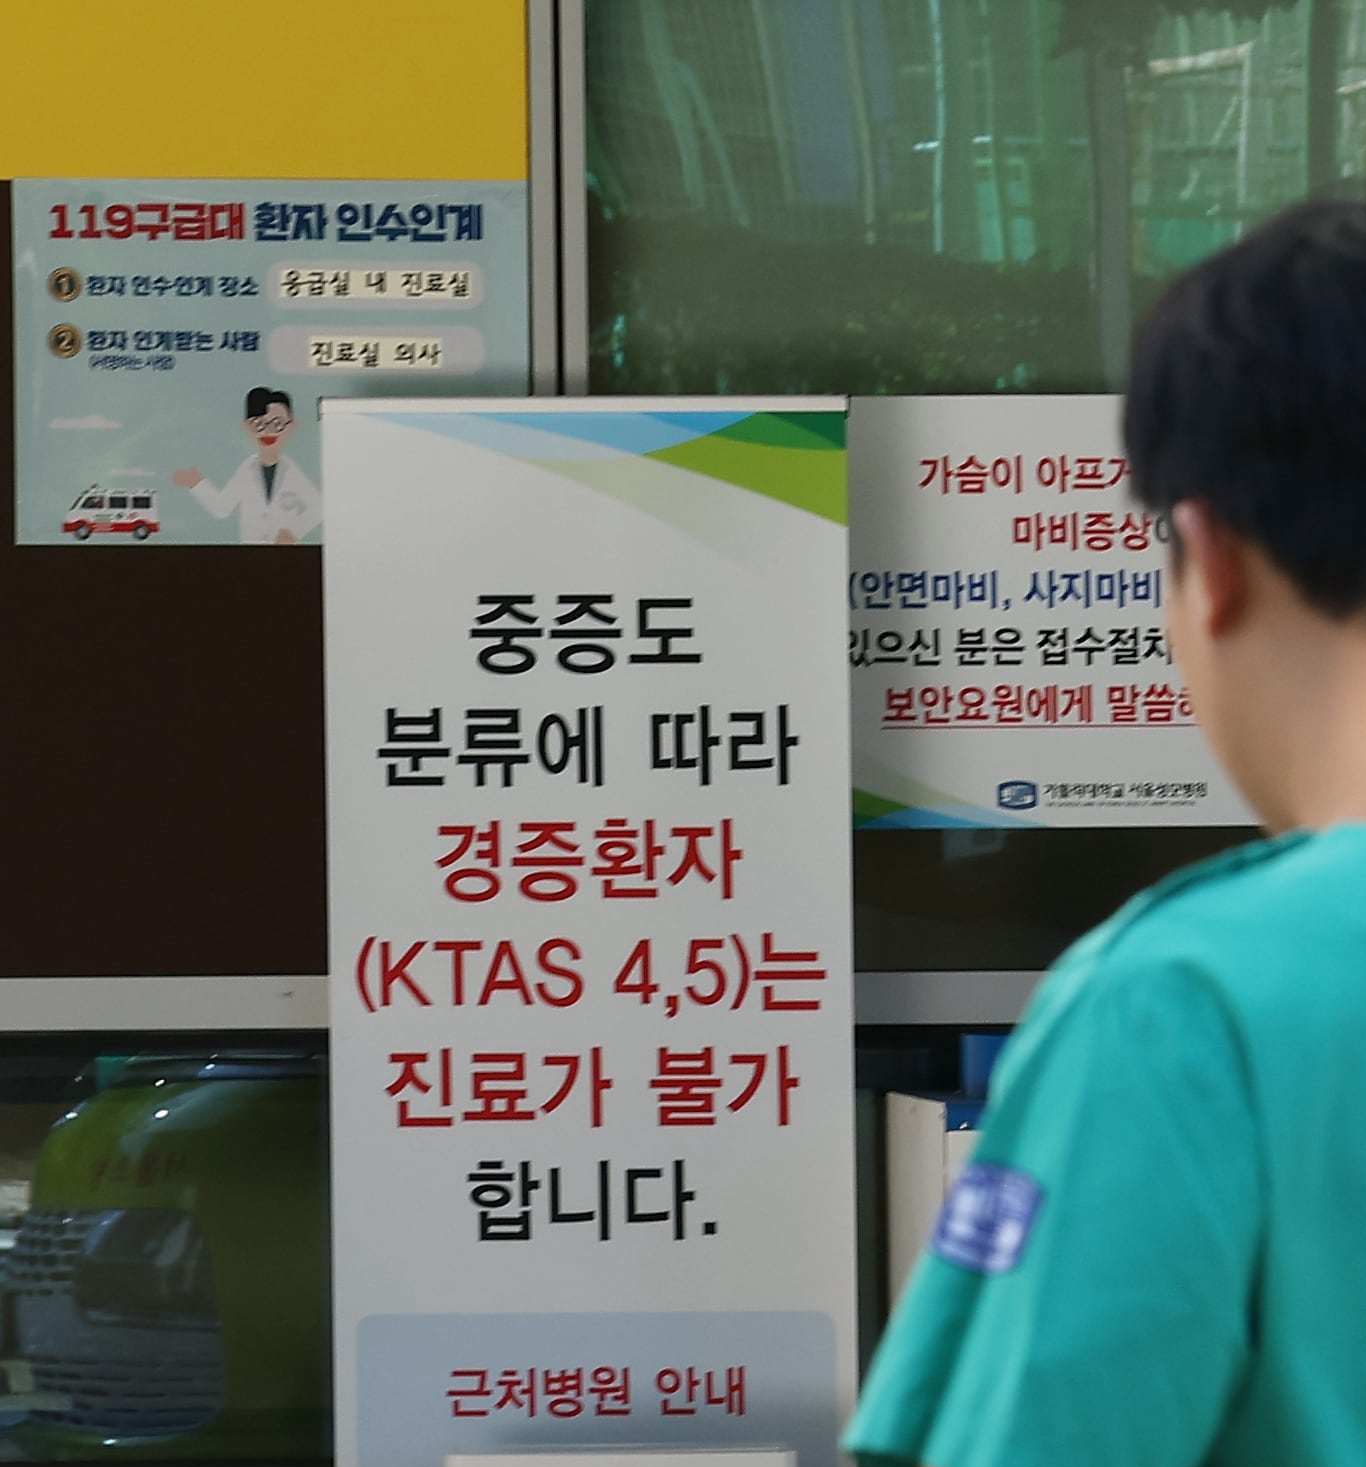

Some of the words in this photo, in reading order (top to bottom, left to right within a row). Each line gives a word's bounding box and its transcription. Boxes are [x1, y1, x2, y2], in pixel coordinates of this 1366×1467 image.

[48, 202, 245, 240] 119구급대
[254, 202, 329, 241] 환자
[335, 202, 483, 241] 인수인계
[86, 275, 126, 296] 환자
[131, 275, 214, 296] 인수인계
[218, 275, 260, 297] 장소
[280, 269, 351, 297] 응급실
[365, 270, 387, 294] 내
[401, 270, 470, 298] 진료실
[87, 330, 128, 351] 환자
[133, 330, 214, 352] 인계받는
[219, 330, 260, 352] 사람
[311, 341, 380, 368] 진료실
[394, 342, 443, 366] 의사
[918, 455, 1024, 494] 가슴이
[848, 570, 1012, 611] (안면마비,
[468, 593, 703, 675] 중증도
[953, 627, 1026, 667] 분은
[881, 684, 1094, 725] 보안요원에게
[377, 705, 605, 788] 분류에
[649, 704, 800, 787] 따라
[435, 818, 743, 903] 경증환자
[356, 936, 585, 1013] (KTAS
[613, 932, 827, 1019] 4,5)는
[384, 1045, 613, 1129] 진료가
[649, 1045, 800, 1128] 불가
[466, 1159, 719, 1243] 합니다.
[446, 1366, 633, 1419] 근처병원
[655, 1365, 748, 1418] 안내
